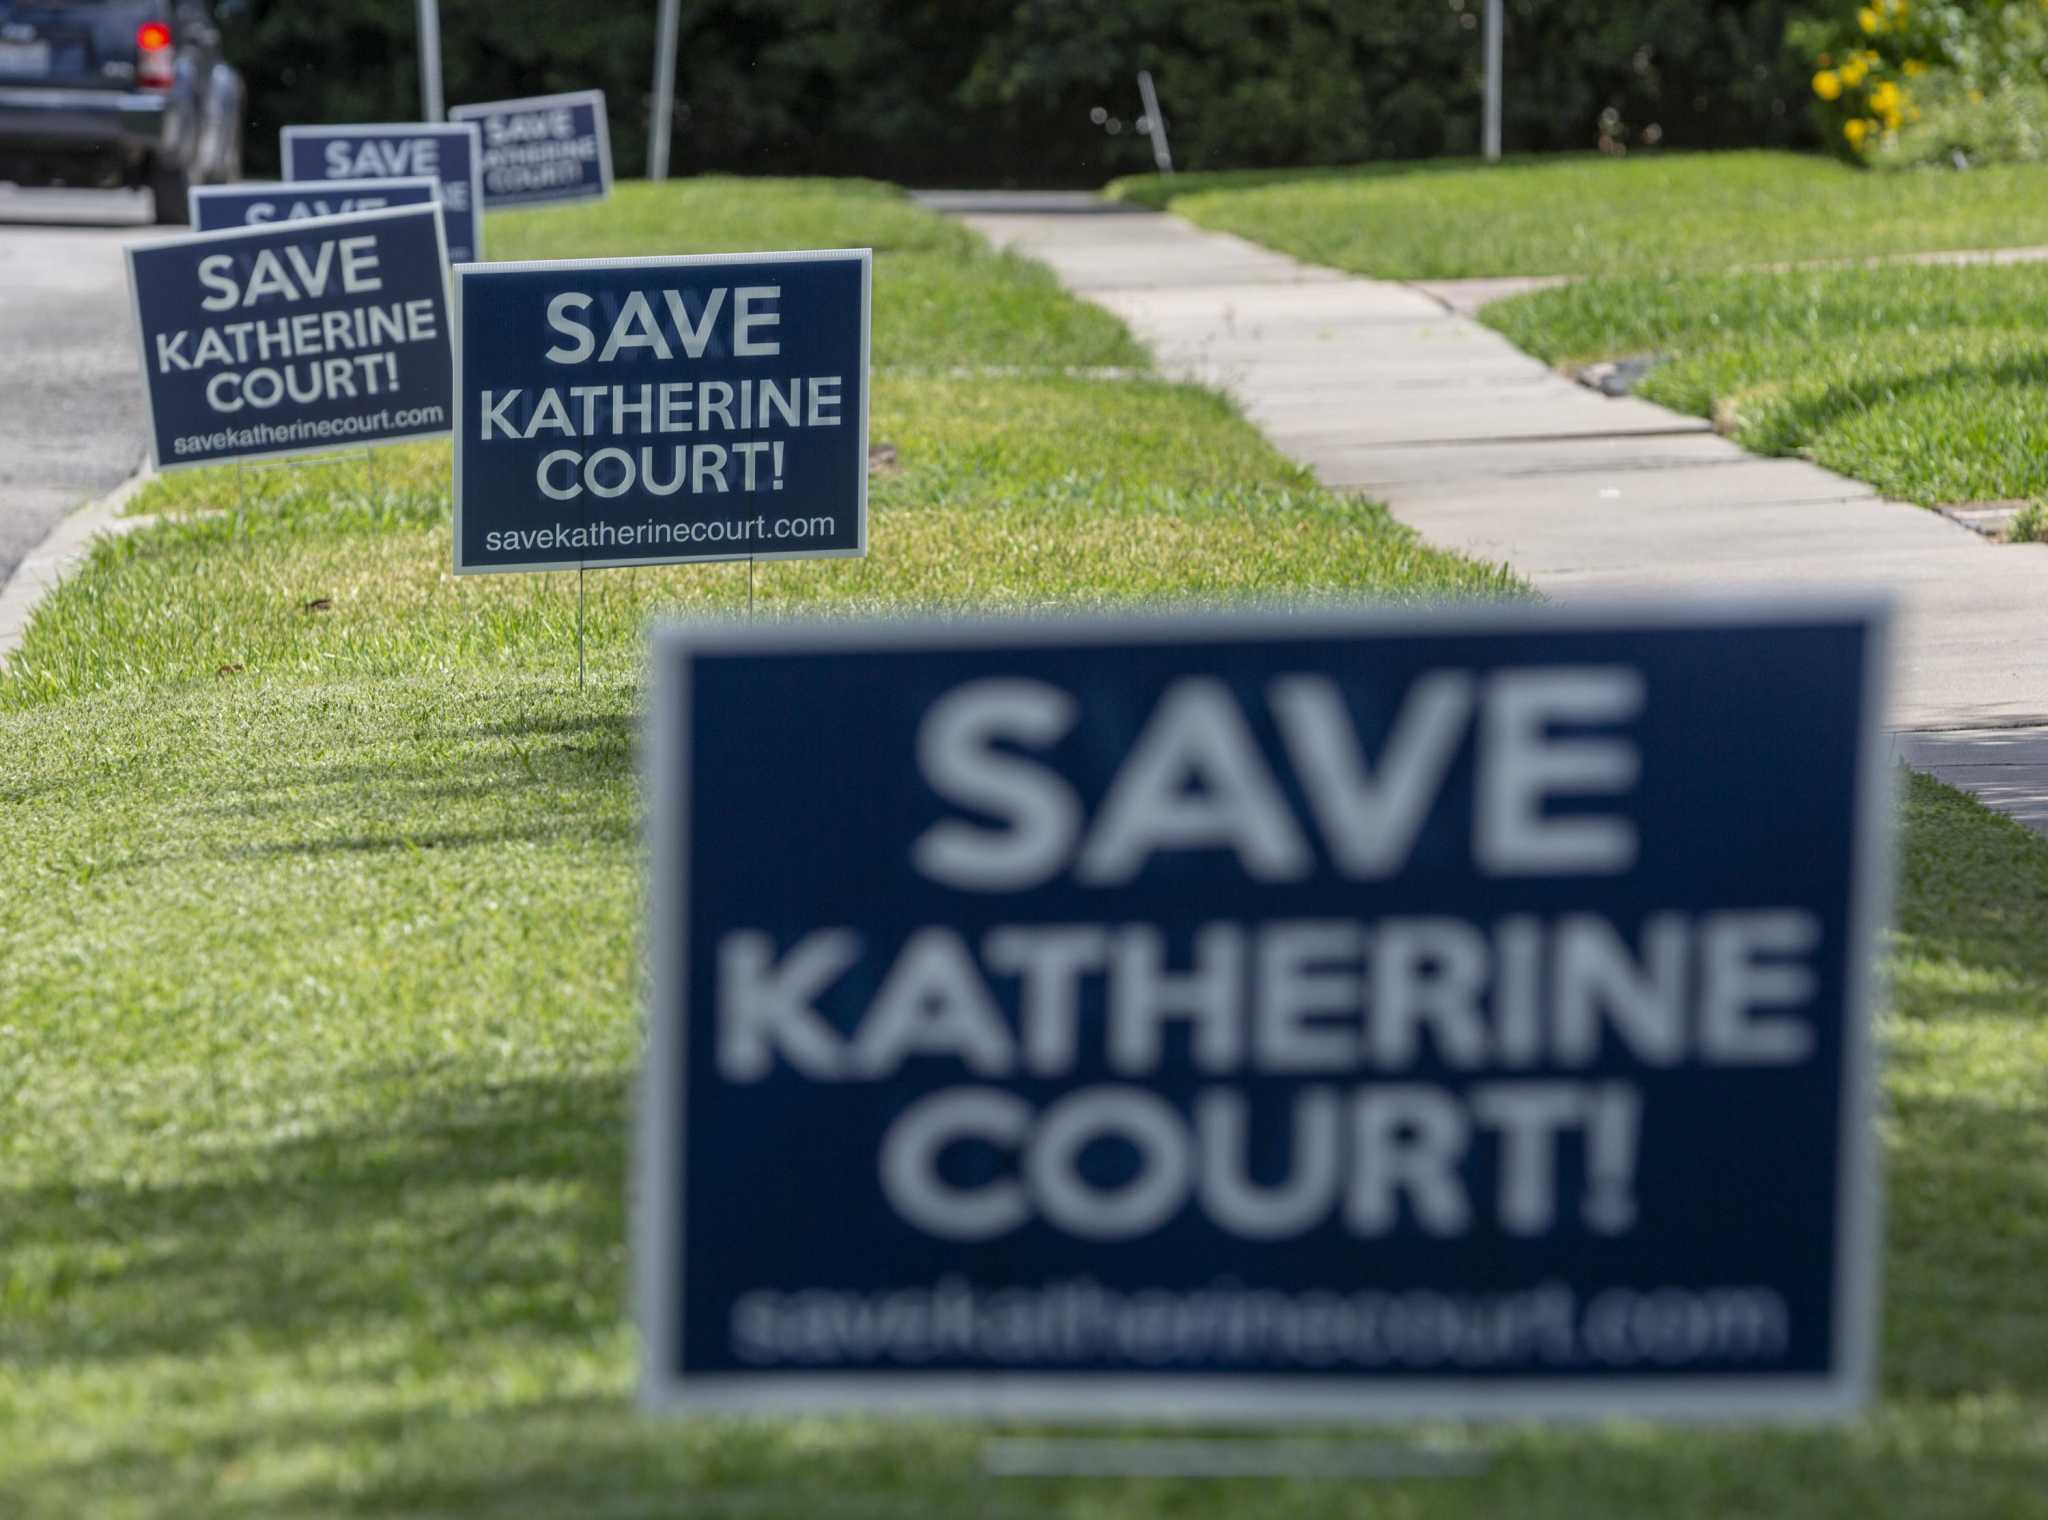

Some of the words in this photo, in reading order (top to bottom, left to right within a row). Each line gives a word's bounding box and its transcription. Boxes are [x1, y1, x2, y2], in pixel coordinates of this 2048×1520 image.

[324, 138, 439, 177] SAVE
[198, 235, 382, 312] SAVE
[156, 299, 437, 374] KATHERINE
[545, 286, 781, 364] SAVE
[206, 352, 399, 412] COURT!
[481, 376, 841, 440] KATHERINE
[173, 405, 444, 455] savekatherinecourt.com
[537, 441, 784, 500] COURT!
[486, 515, 835, 551] savekatherinecourt.com
[915, 665, 1645, 890] SAVE
[716, 909, 1818, 1083] KATHERINE
[879, 1082, 1641, 1240] COURT!
